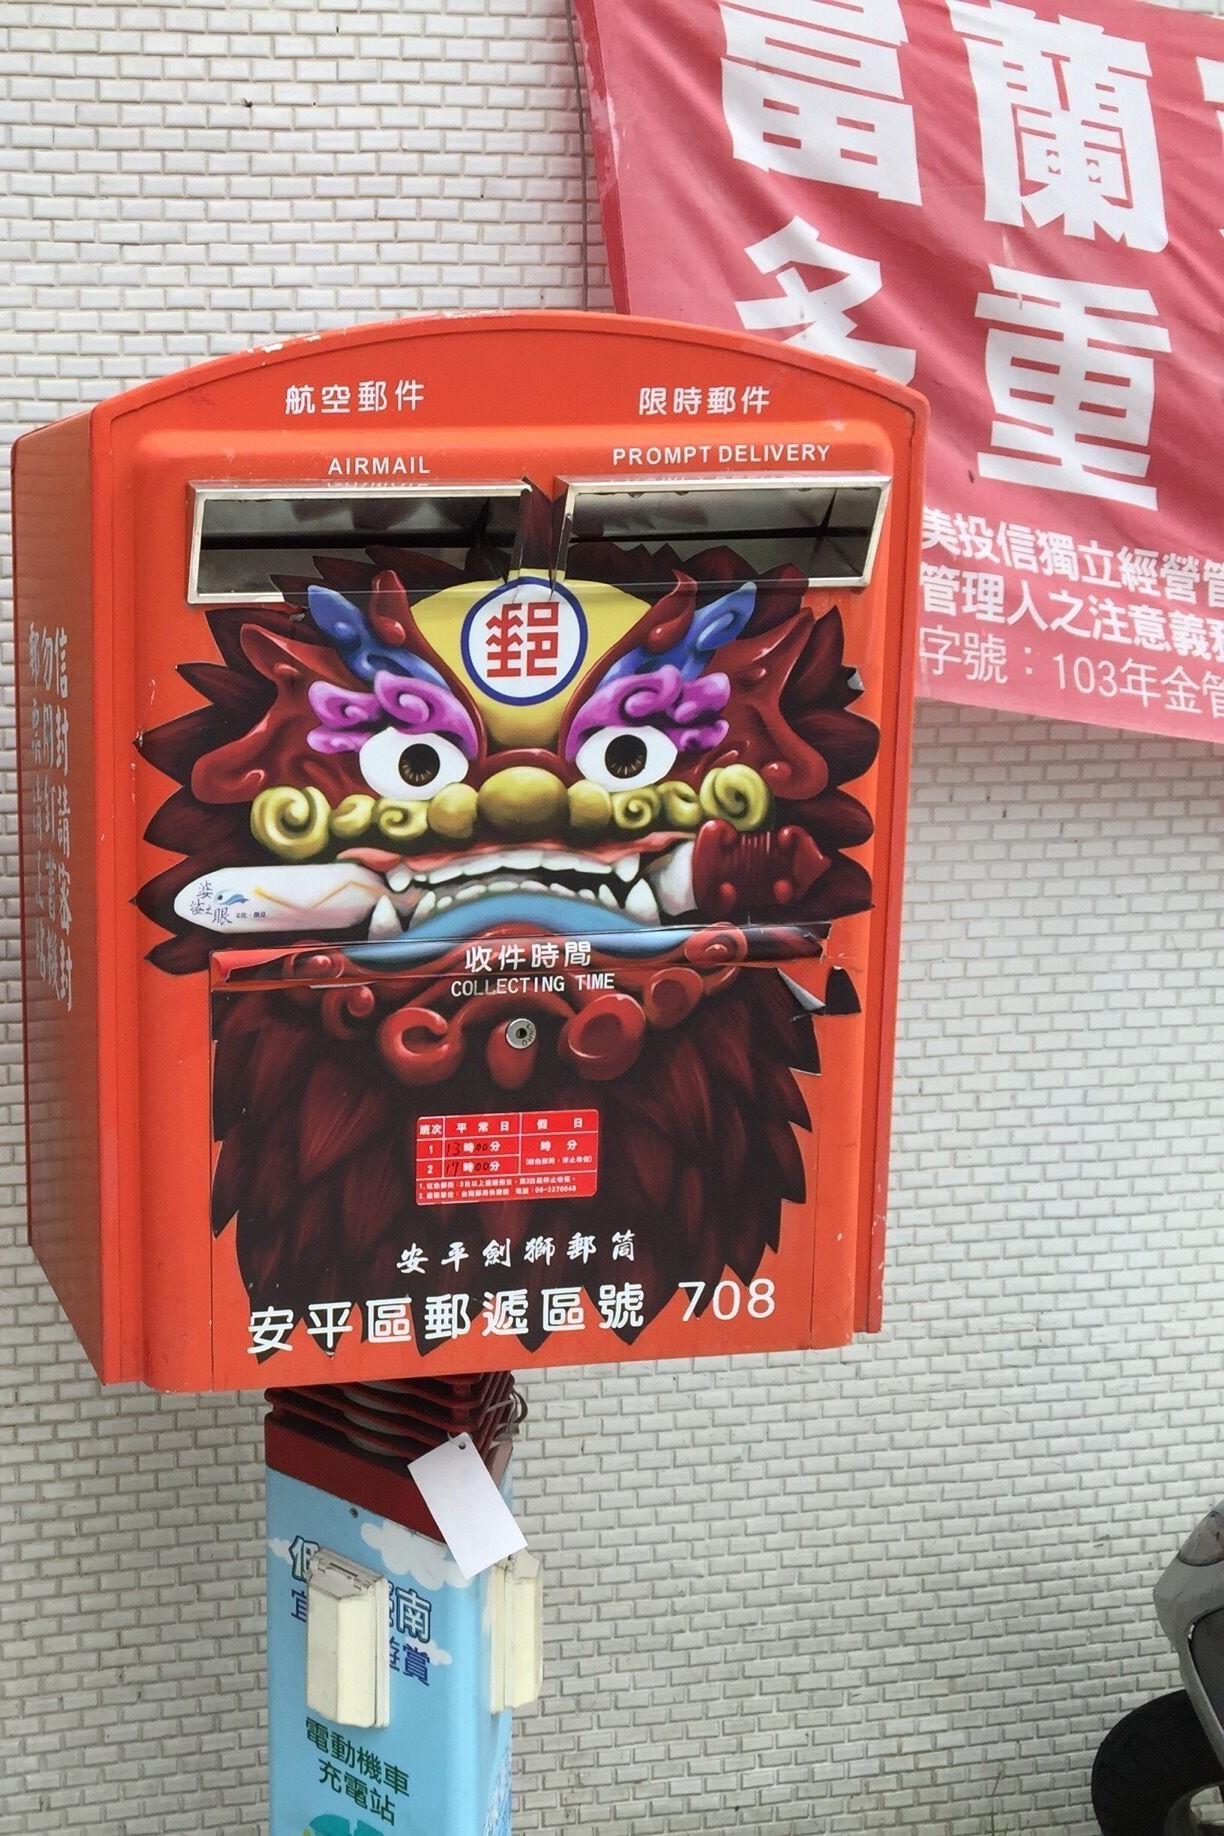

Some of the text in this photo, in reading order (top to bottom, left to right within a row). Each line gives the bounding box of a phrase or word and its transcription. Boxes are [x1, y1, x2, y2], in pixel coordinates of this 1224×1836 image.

[720, 0, 1224, 253] 富蘭
[285, 379, 426, 416] 航空郵件
[638, 385, 771, 416] 限時郵件
[328, 455, 431, 477] AIRMAIL
[612, 443, 831, 466] PROMPT DELIVERY
[464, 940, 592, 973] 收件時間
[451, 973, 615, 997] COLLECTING TIME
[396, 1229, 636, 1274] 安平劍獅郵筒
[247, 1277, 776, 1355] 安平區郵遞區號 708
[305, 1716, 410, 1797] 電動機車
[318, 1758, 396, 1826] 充電站
